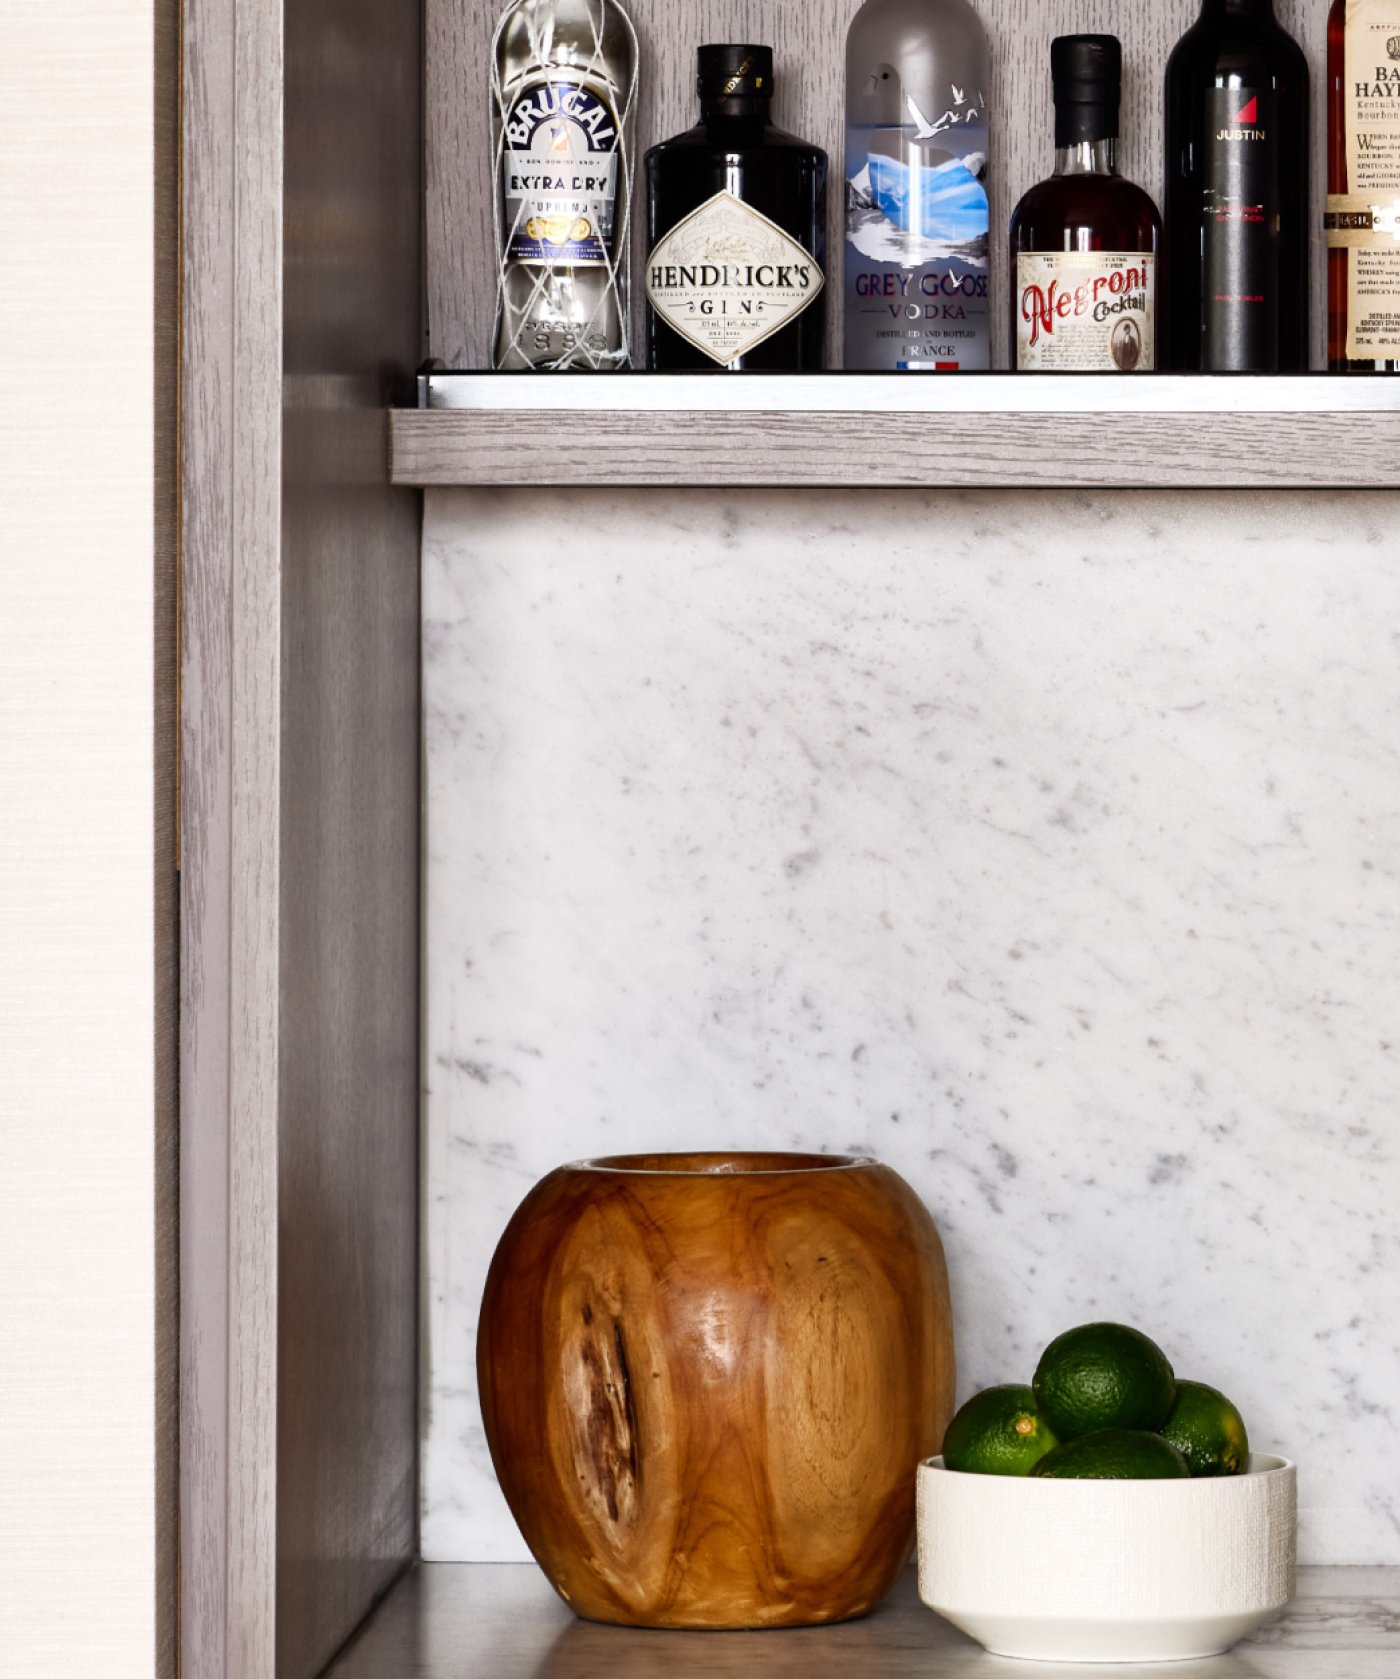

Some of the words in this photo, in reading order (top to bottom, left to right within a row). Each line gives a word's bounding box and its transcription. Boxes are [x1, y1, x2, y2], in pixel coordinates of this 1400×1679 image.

[1357, 101, 1400, 109] Kentucky
[508, 88, 614, 150] BRUGAL
[1357, 111, 1399, 119] Bourbon
[1216, 129, 1265, 140] JUSTIN
[511, 175, 565, 190] EXTRA
[572, 176, 607, 191] DRY
[651, 264, 811, 289] HENDRICK'S
[856, 273, 913, 297] GREY
[919, 273, 987, 298] GOOSE
[700, 300, 752, 314] GIN
[1021, 259, 1148, 347] Negroni
[1093, 293, 1146, 322] Cocktail
[889, 303, 967, 320] VODKA
[901, 345, 956, 356] FRANCE
